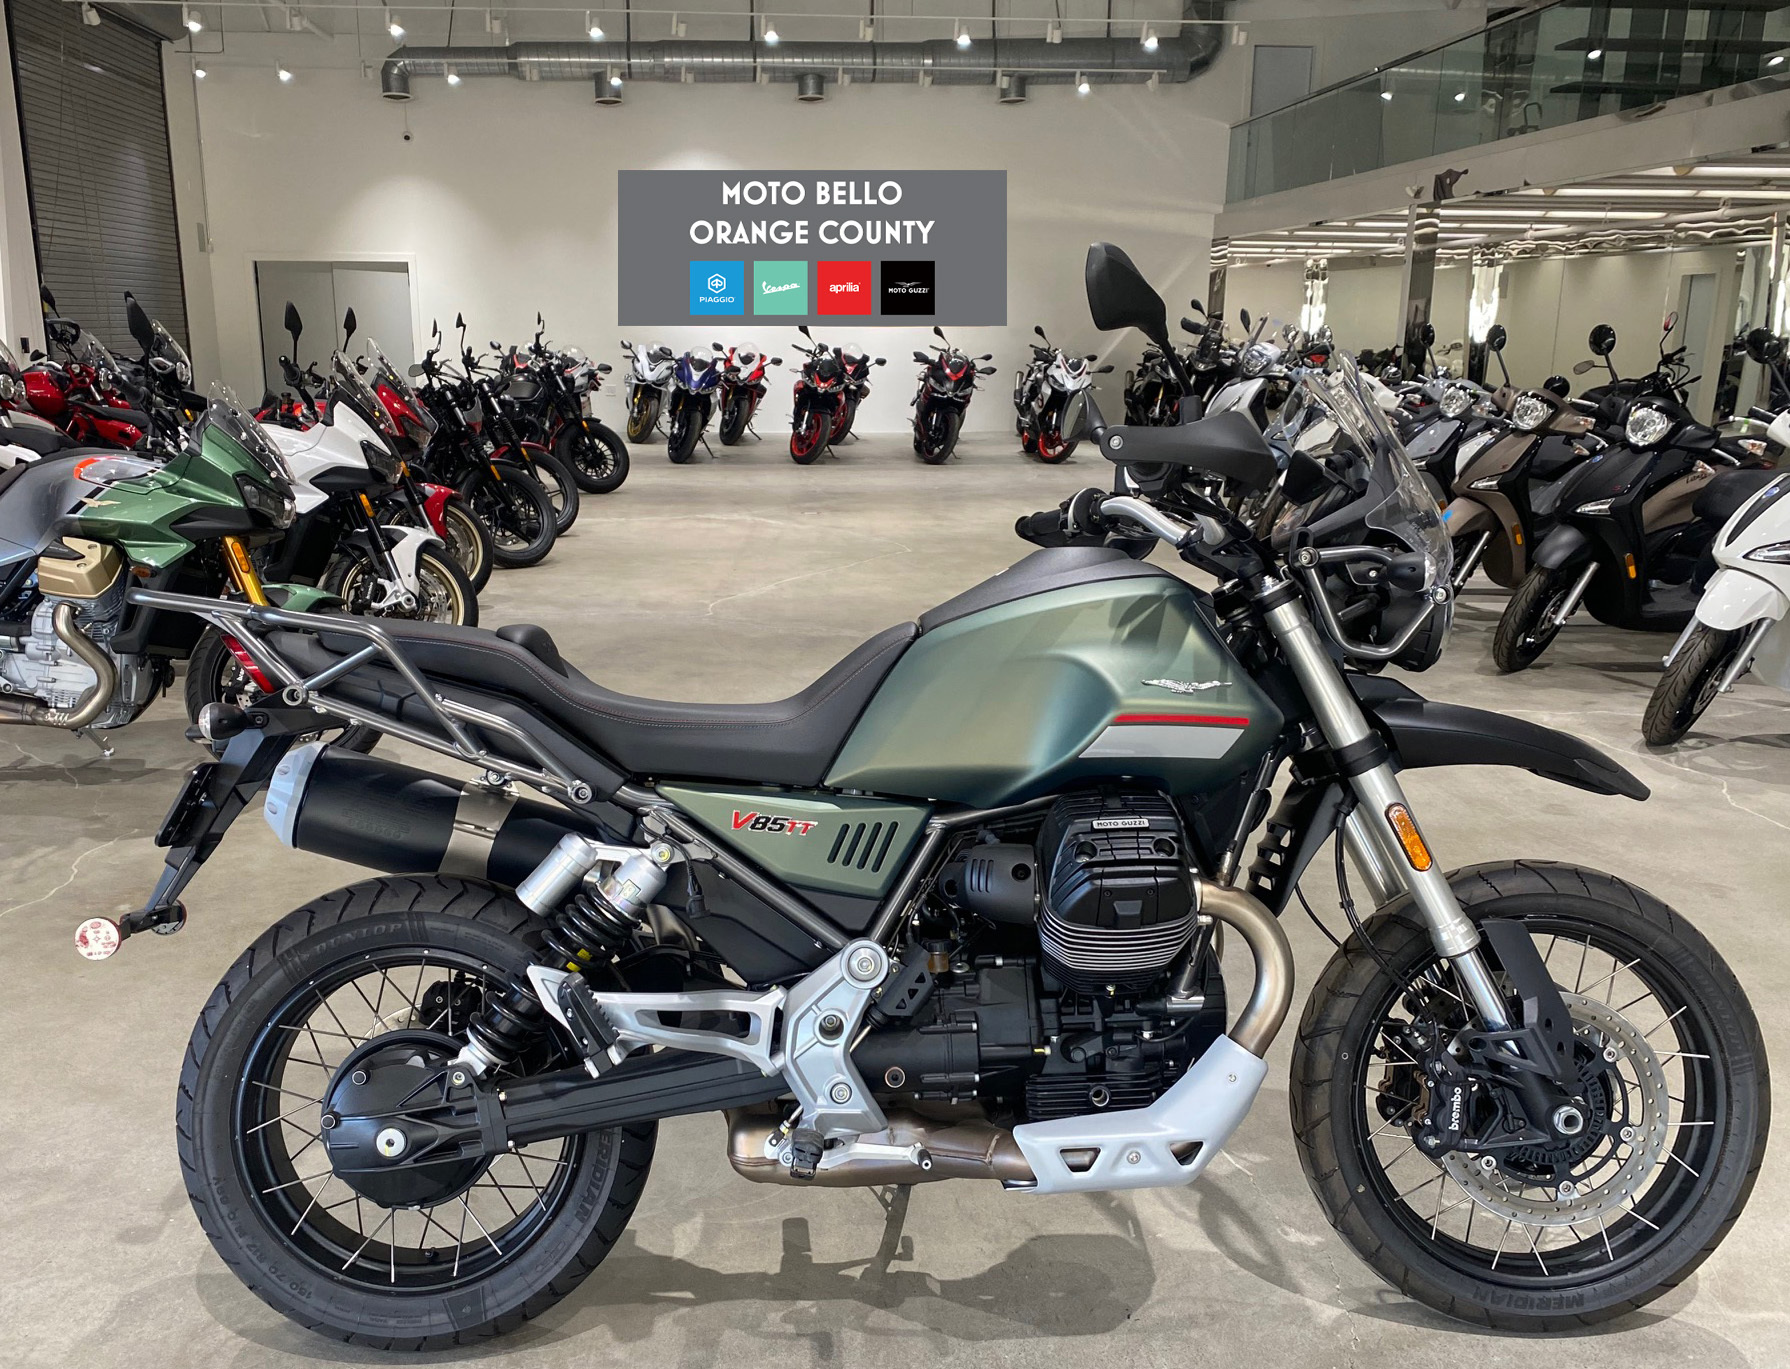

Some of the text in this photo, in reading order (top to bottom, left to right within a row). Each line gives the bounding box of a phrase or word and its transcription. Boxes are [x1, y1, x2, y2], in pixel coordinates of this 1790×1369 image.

[731, 810, 819, 836] V85TT
[1448, 1087, 1462, 1130] brembo
[574, 1126, 613, 1224] ERIDIAN
